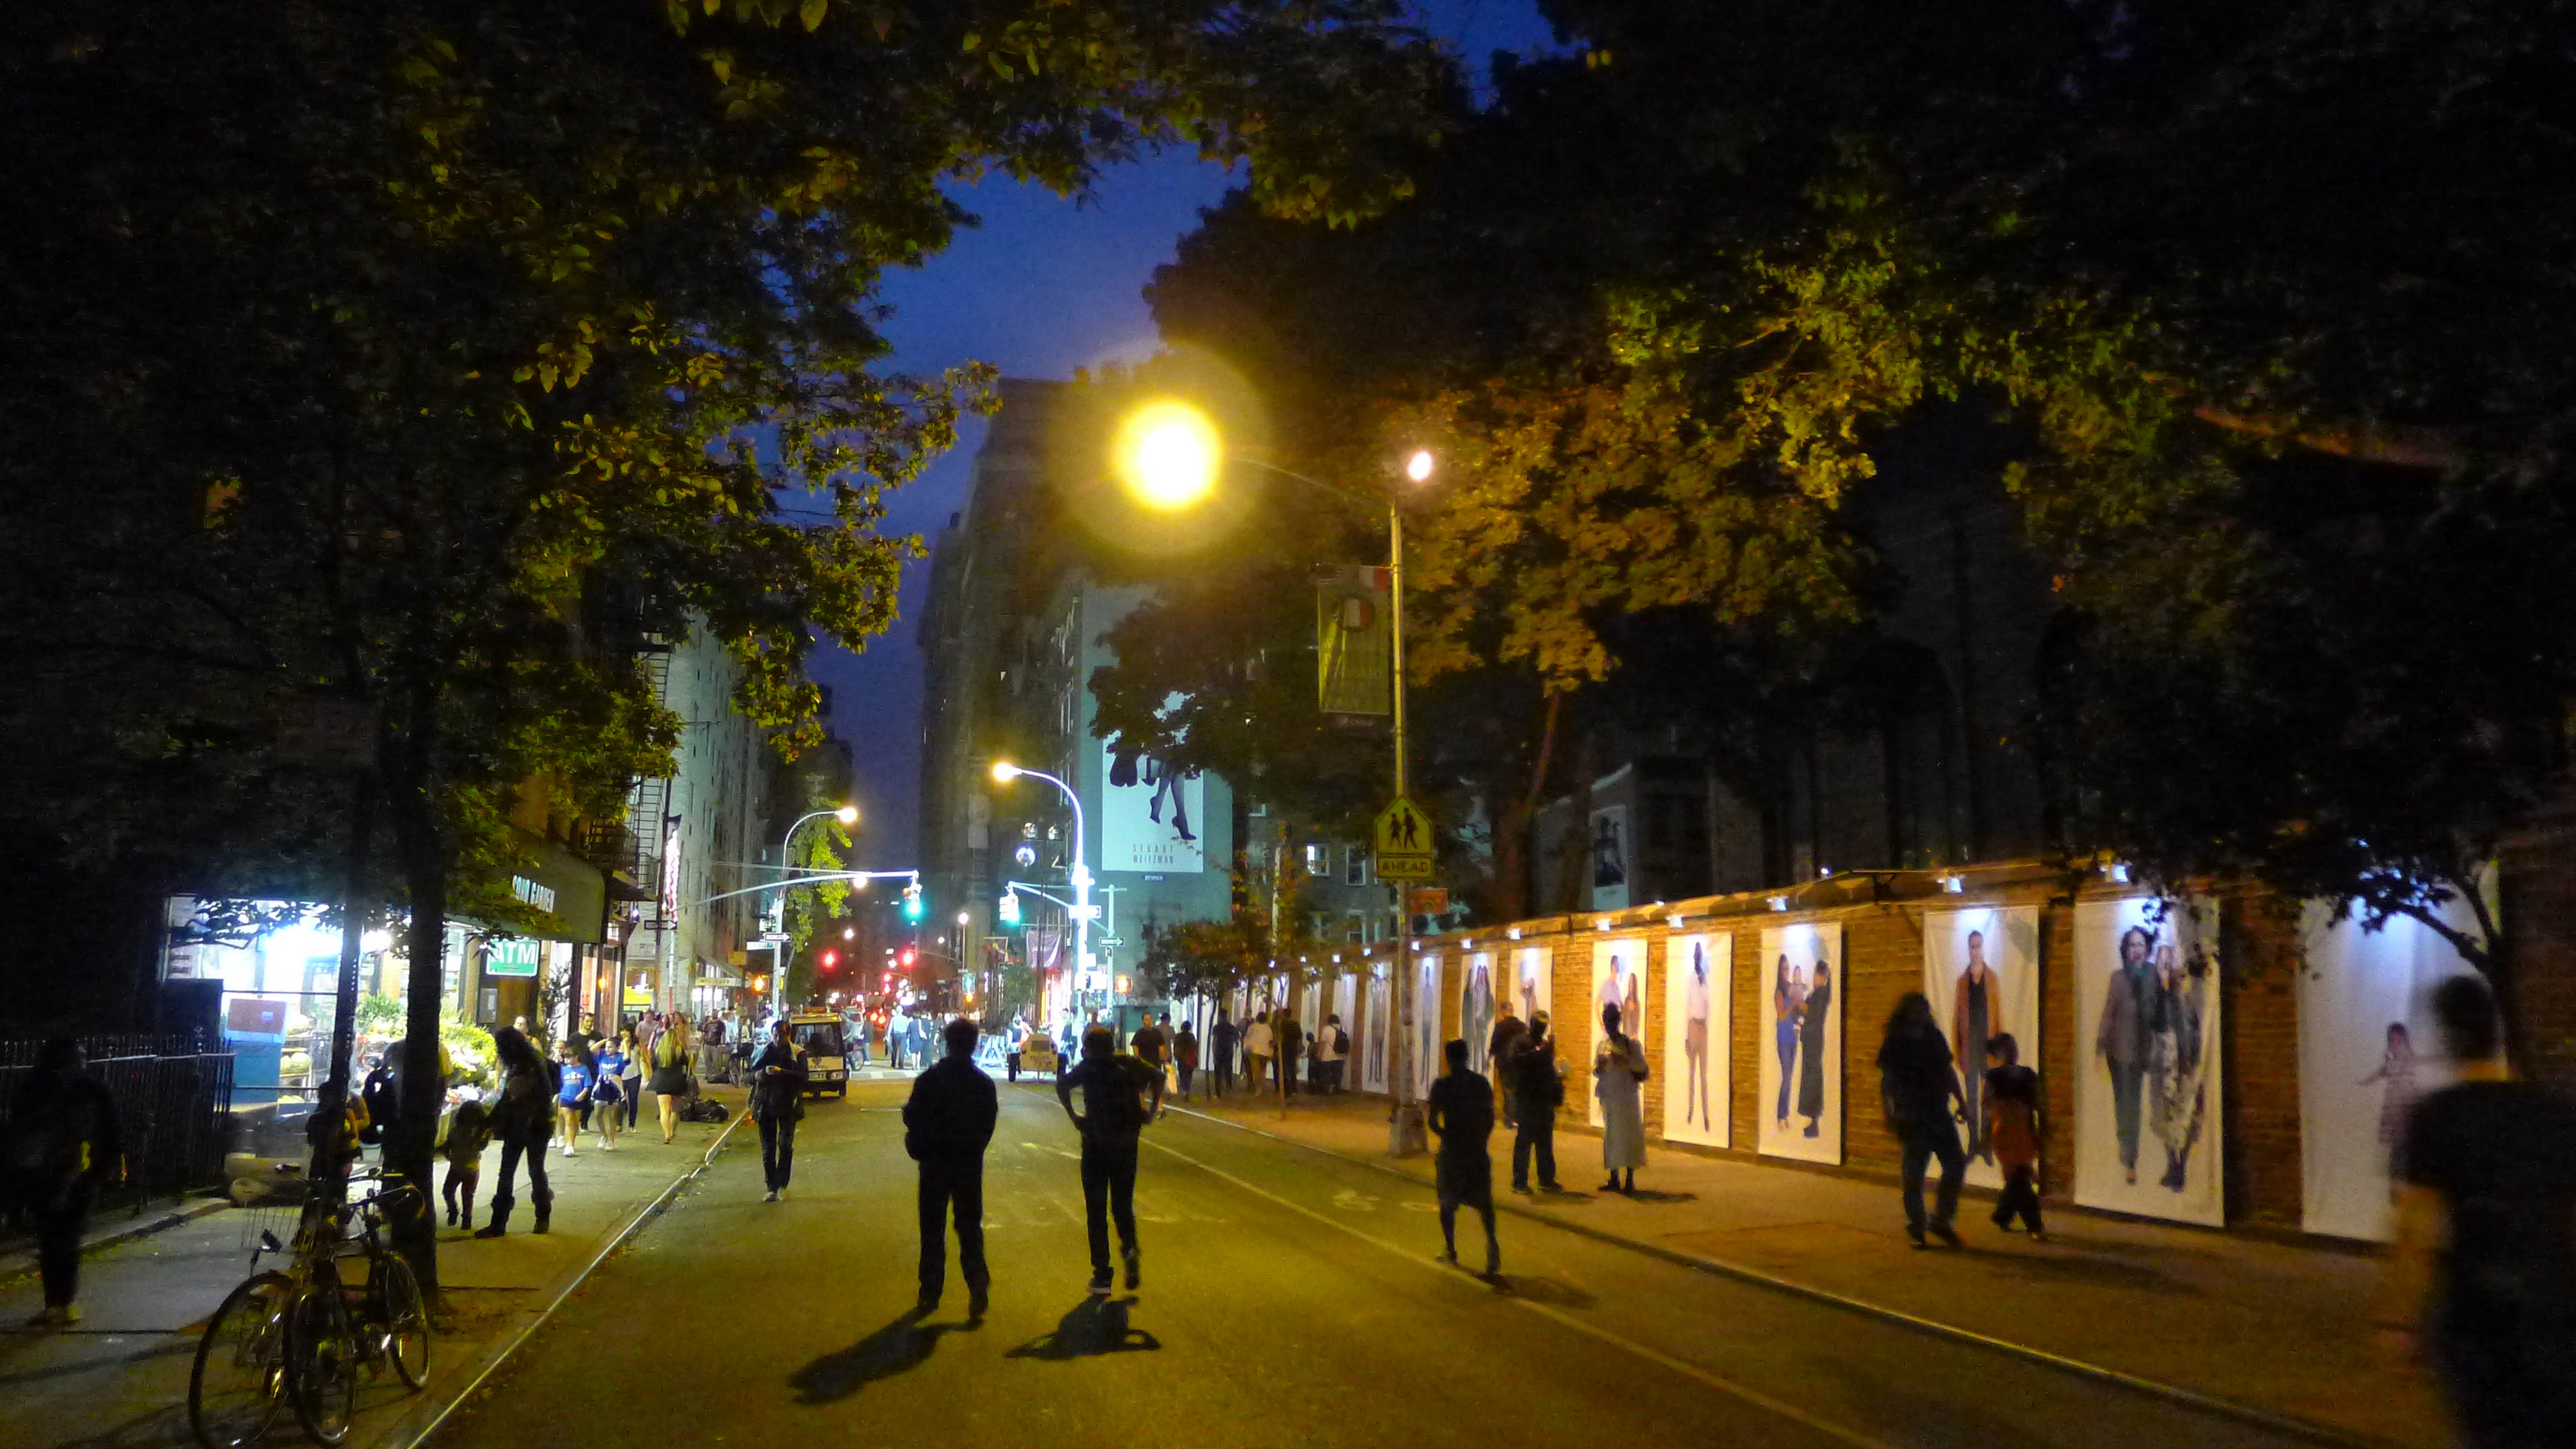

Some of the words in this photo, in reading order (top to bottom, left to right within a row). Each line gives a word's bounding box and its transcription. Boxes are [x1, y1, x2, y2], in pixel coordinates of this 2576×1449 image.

[1133, 844, 1173, 853] STUART
[1133, 855, 1174, 863] WEITZMAN
[1381, 861, 1429, 873] AHEAD
[491, 941, 536, 964] ATM
